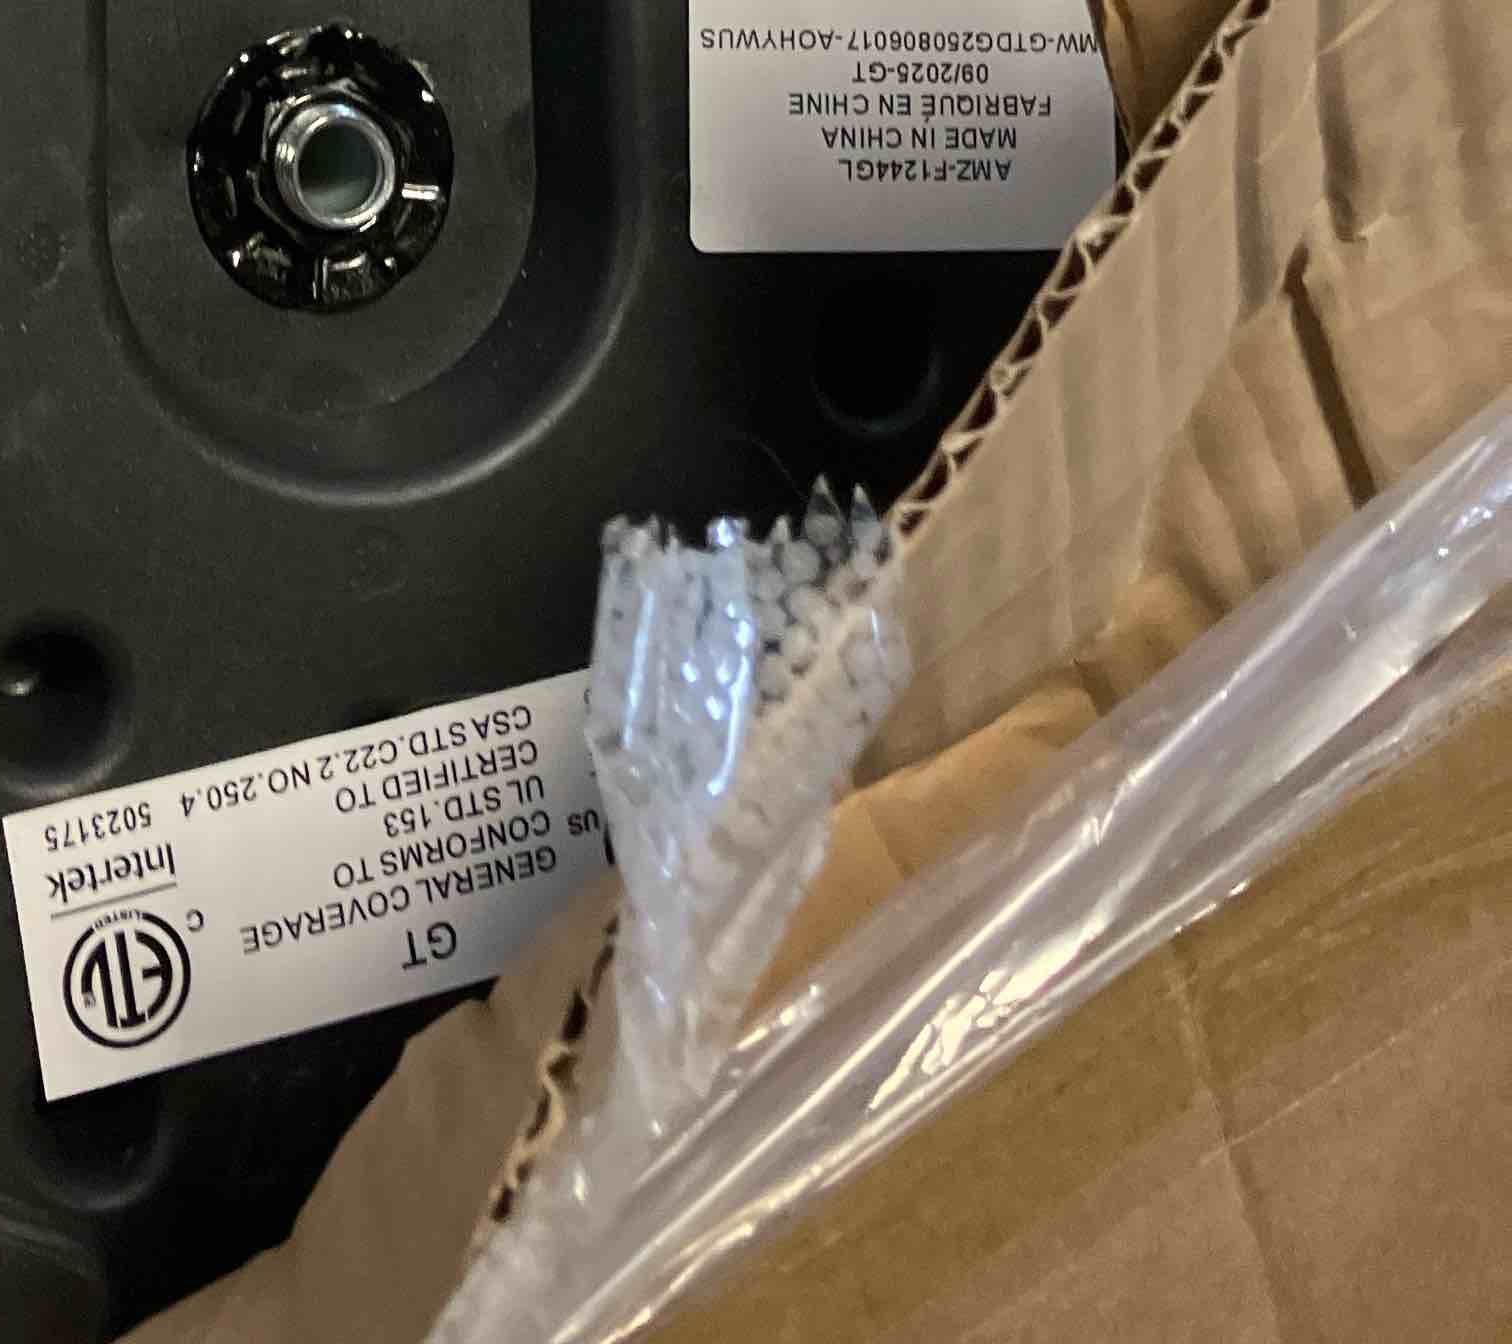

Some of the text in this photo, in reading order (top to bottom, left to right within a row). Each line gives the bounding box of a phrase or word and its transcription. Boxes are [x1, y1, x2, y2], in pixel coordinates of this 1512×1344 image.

[852, 61, 988, 84] 09/2025-GT
[789, 93, 1051, 123] FABRIQUÉ EN CHINE
[821, 126, 1016, 149] MADE IN CHINA
[838, 159, 1011, 182] AMZ-F1244GL
[471, 705, 531, 740] CSA
[181, 762, 311, 817] NO.250.4
[336, 740, 537, 813] CERTIFIED TO
[45, 802, 151, 851] 5023175
[384, 775, 544, 838] UL STD.153
[567, 809, 600, 836] US
[47, 844, 175, 903] Intertek
[334, 811, 550, 888] CONFORMS TO
[242, 846, 556, 953] GENERAL COVERAGE
[402, 922, 457, 970] GT
[81, 930, 172, 1029] ETL
